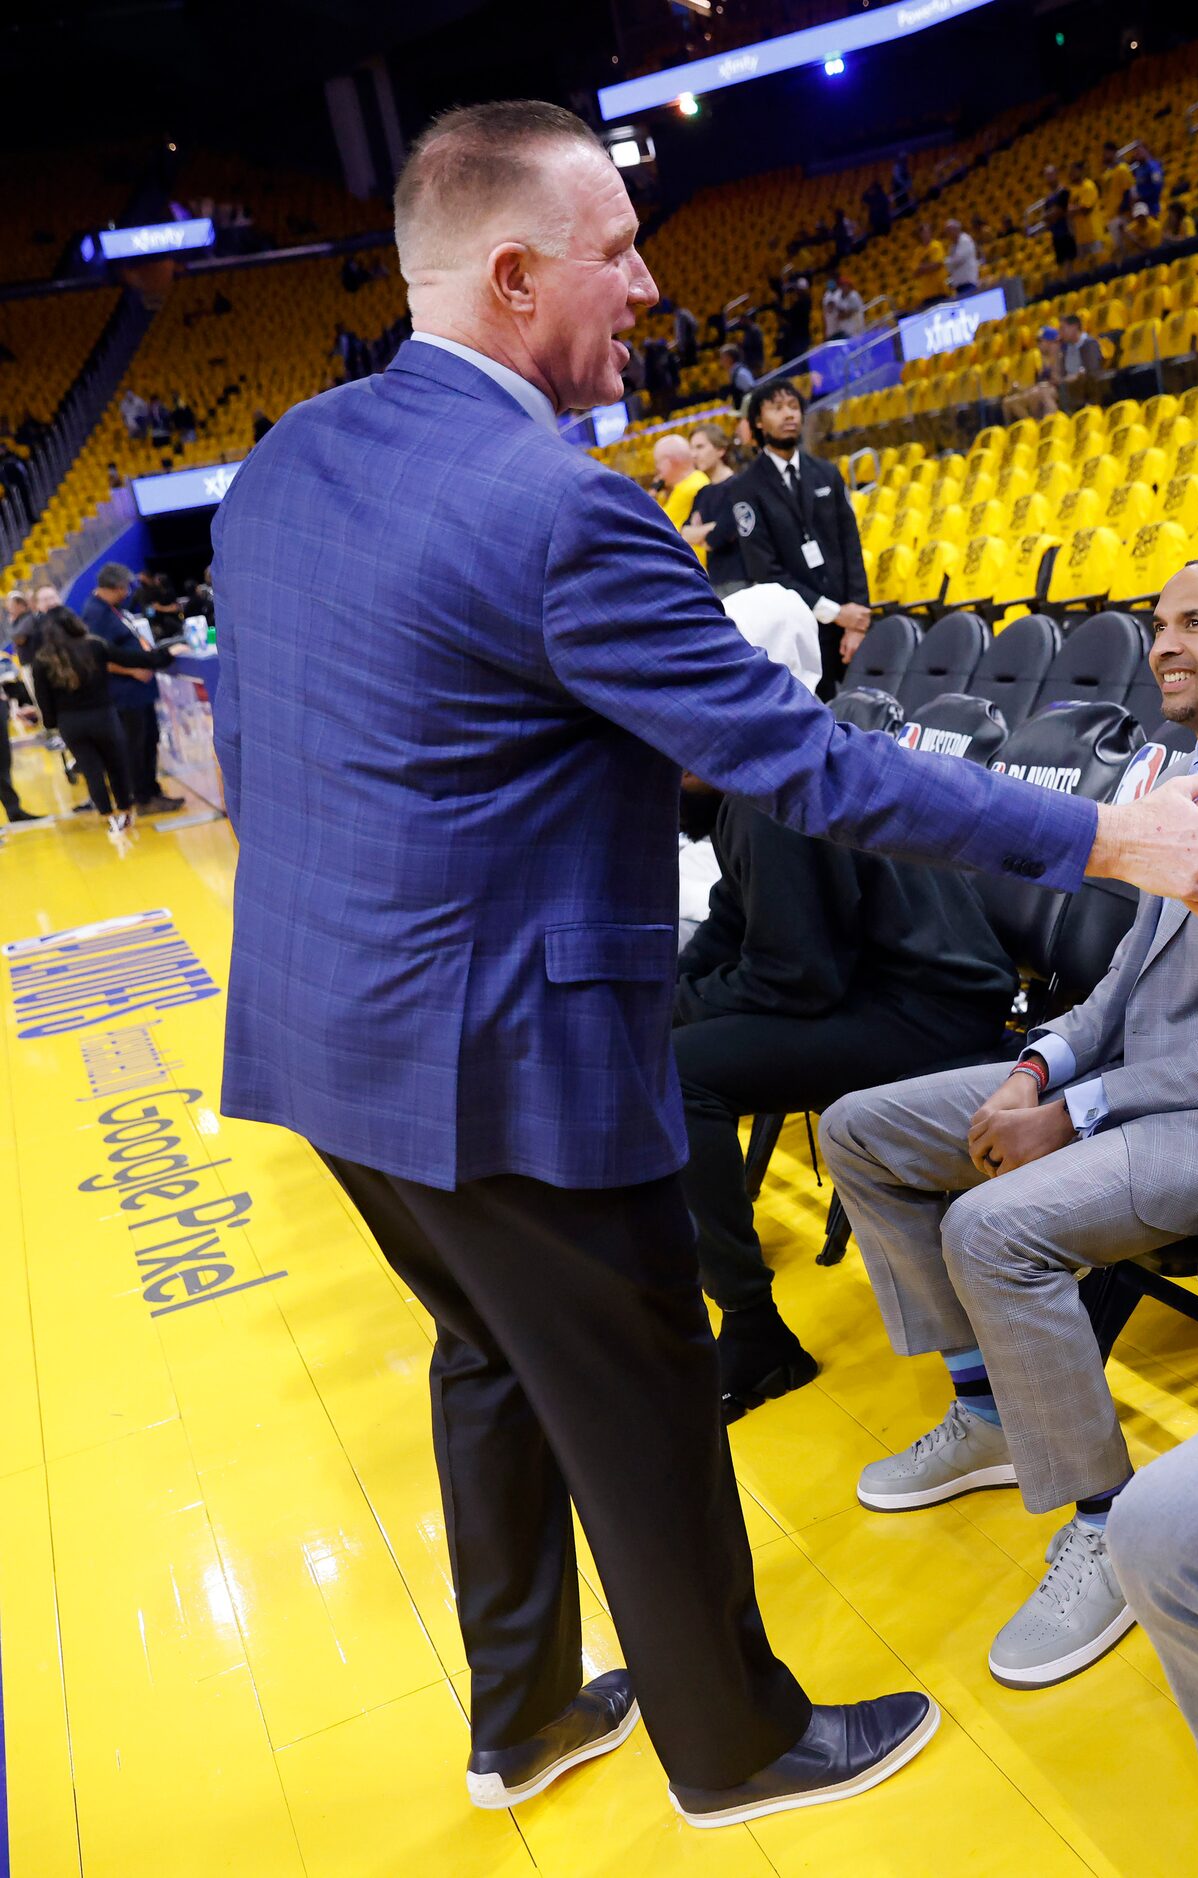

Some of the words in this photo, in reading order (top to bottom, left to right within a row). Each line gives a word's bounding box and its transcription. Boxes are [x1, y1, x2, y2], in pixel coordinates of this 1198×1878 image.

[924, 308, 979, 353] xfinity
[78, 1087, 233, 1211] Google
[128, 1191, 289, 1319] Pixel
